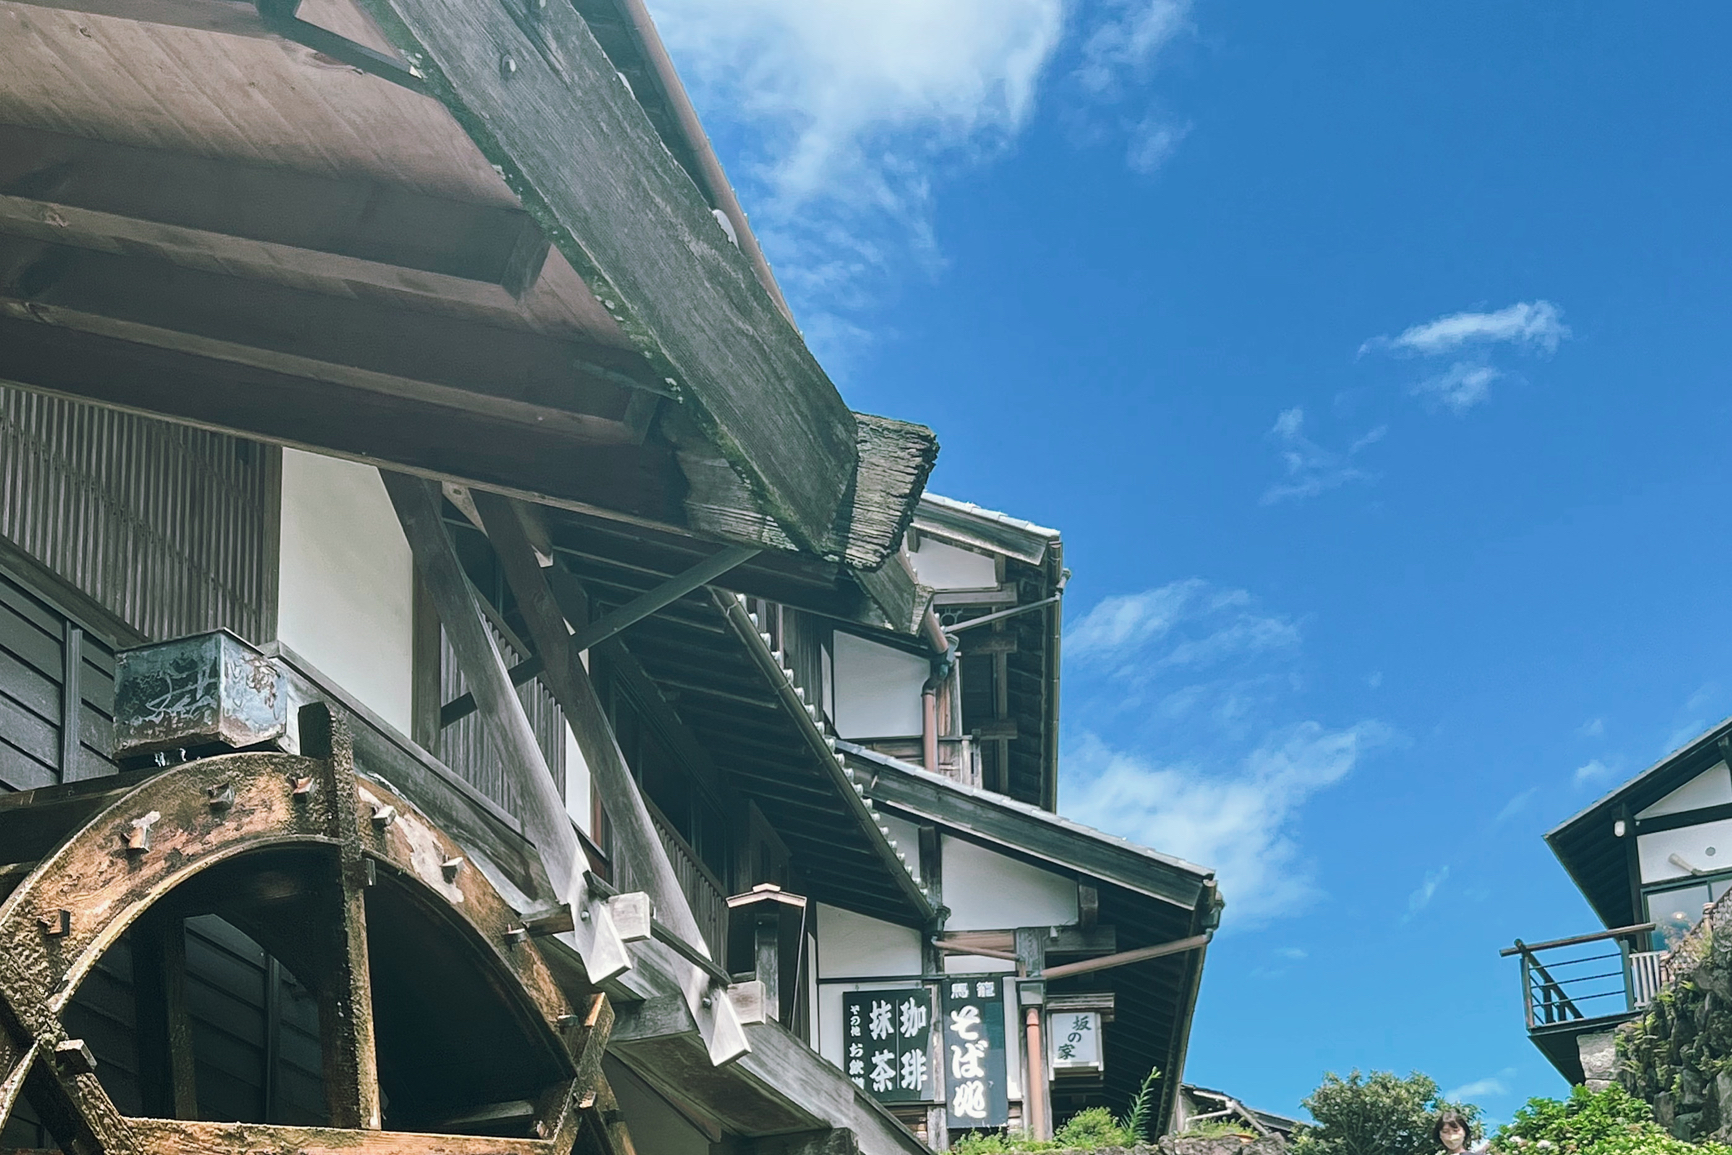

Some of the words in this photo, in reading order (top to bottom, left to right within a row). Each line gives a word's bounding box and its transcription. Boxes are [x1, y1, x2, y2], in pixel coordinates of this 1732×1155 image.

[869, 999, 895, 1092] 抹茶
[900, 997, 927, 1091] 珈琲
[950, 1005, 988, 1118] そば処
[1058, 1015, 1092, 1059] 坂の家
